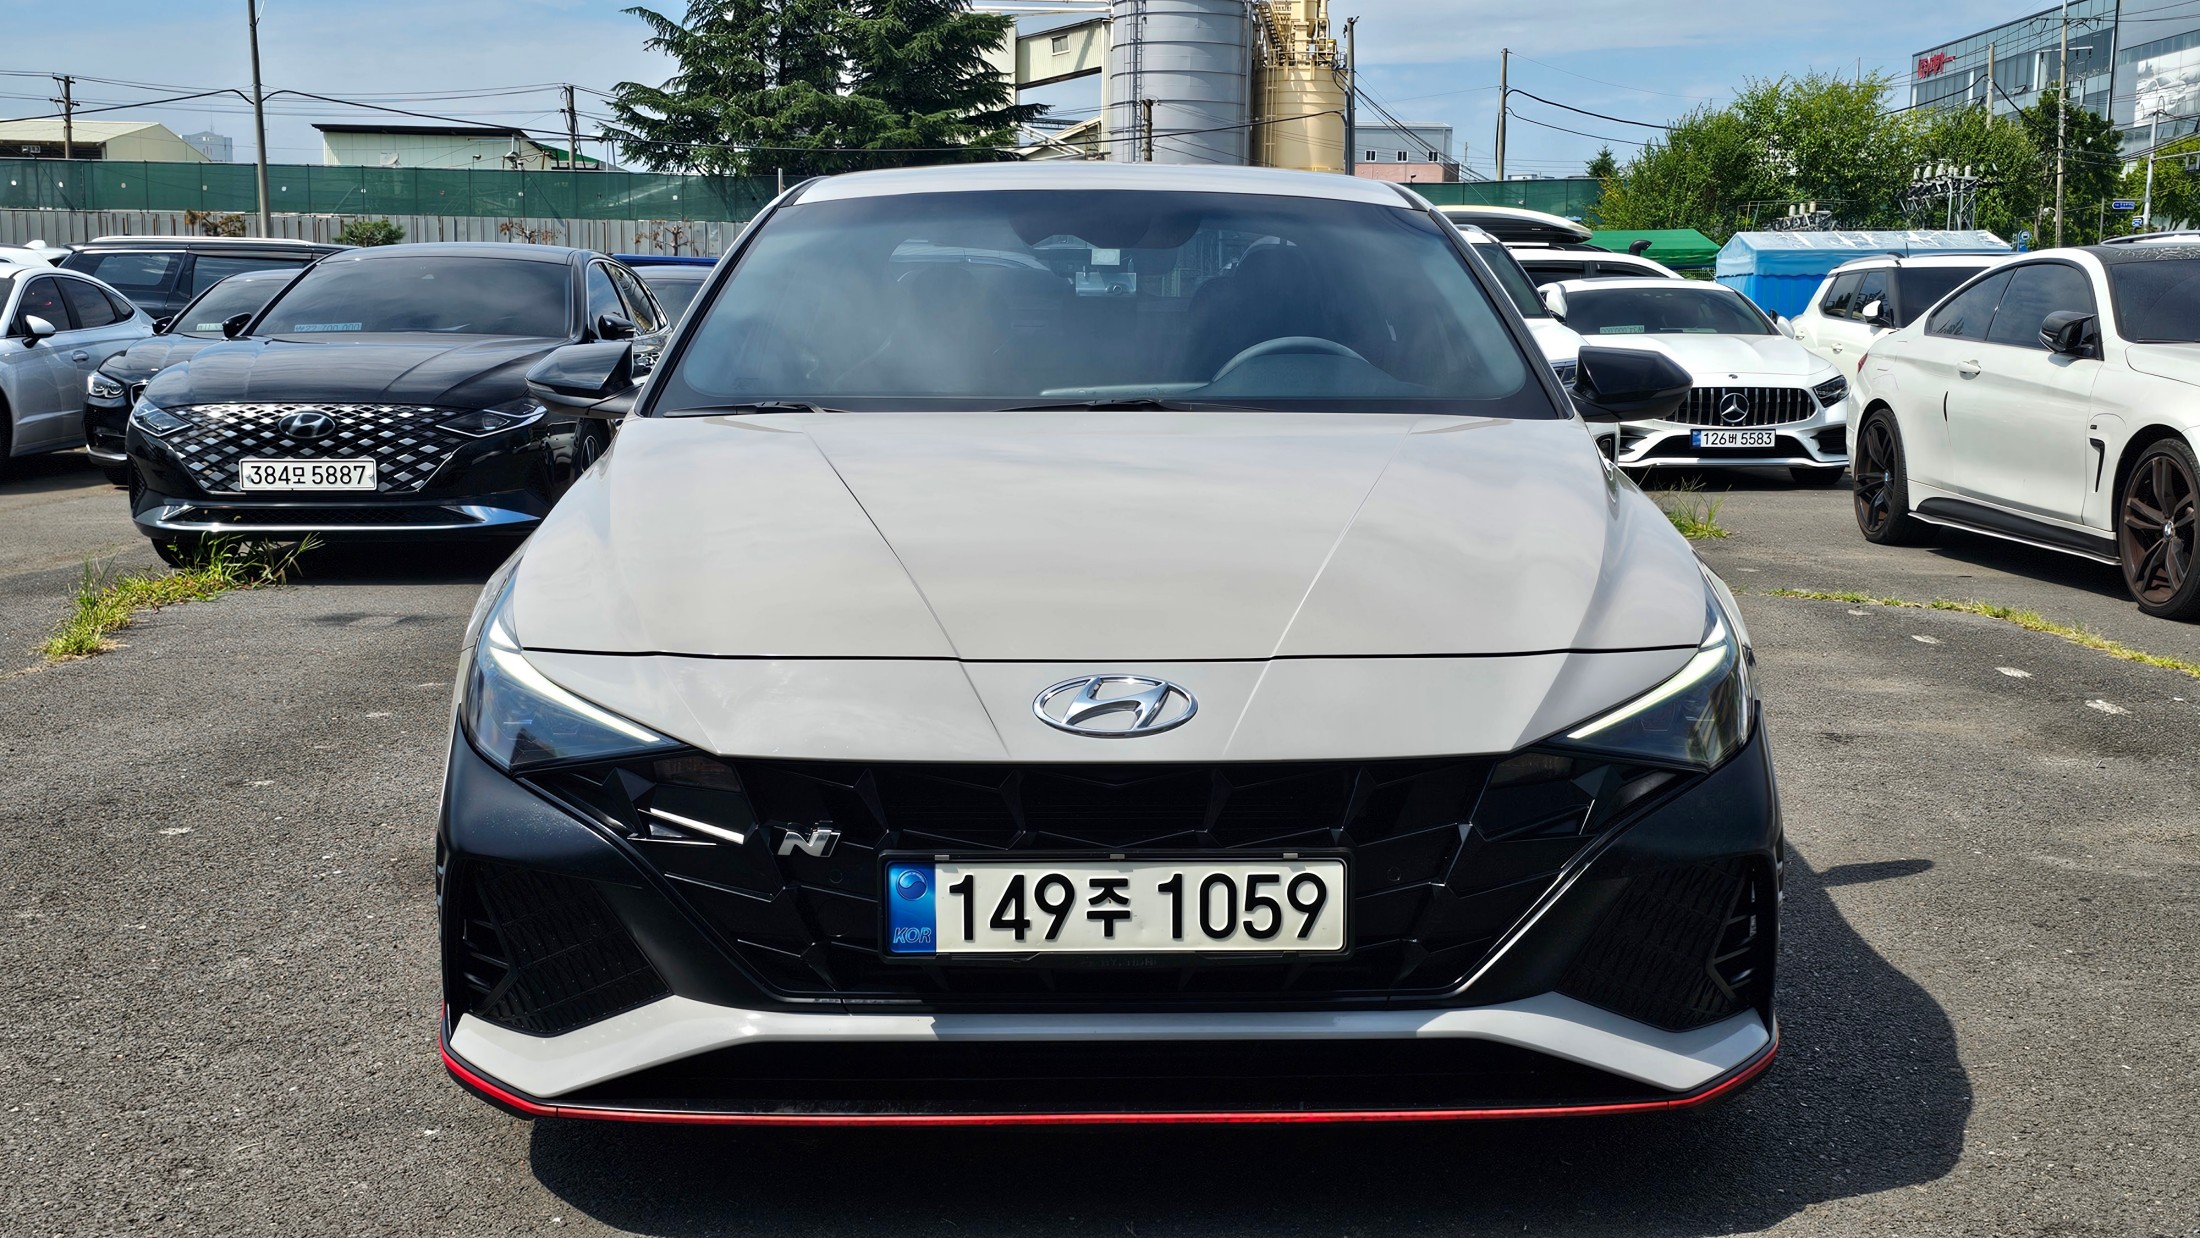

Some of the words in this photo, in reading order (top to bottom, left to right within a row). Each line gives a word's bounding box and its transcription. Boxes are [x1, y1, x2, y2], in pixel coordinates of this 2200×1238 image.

[1703, 432, 1737, 445] 126버
[1740, 432, 1772, 445] 5583
[250, 465, 306, 485] 384모
[311, 465, 366, 485] 5887
[949, 872, 1131, 941] 149주
[1157, 872, 1328, 940] 1059
[893, 927, 931, 944] KOR
